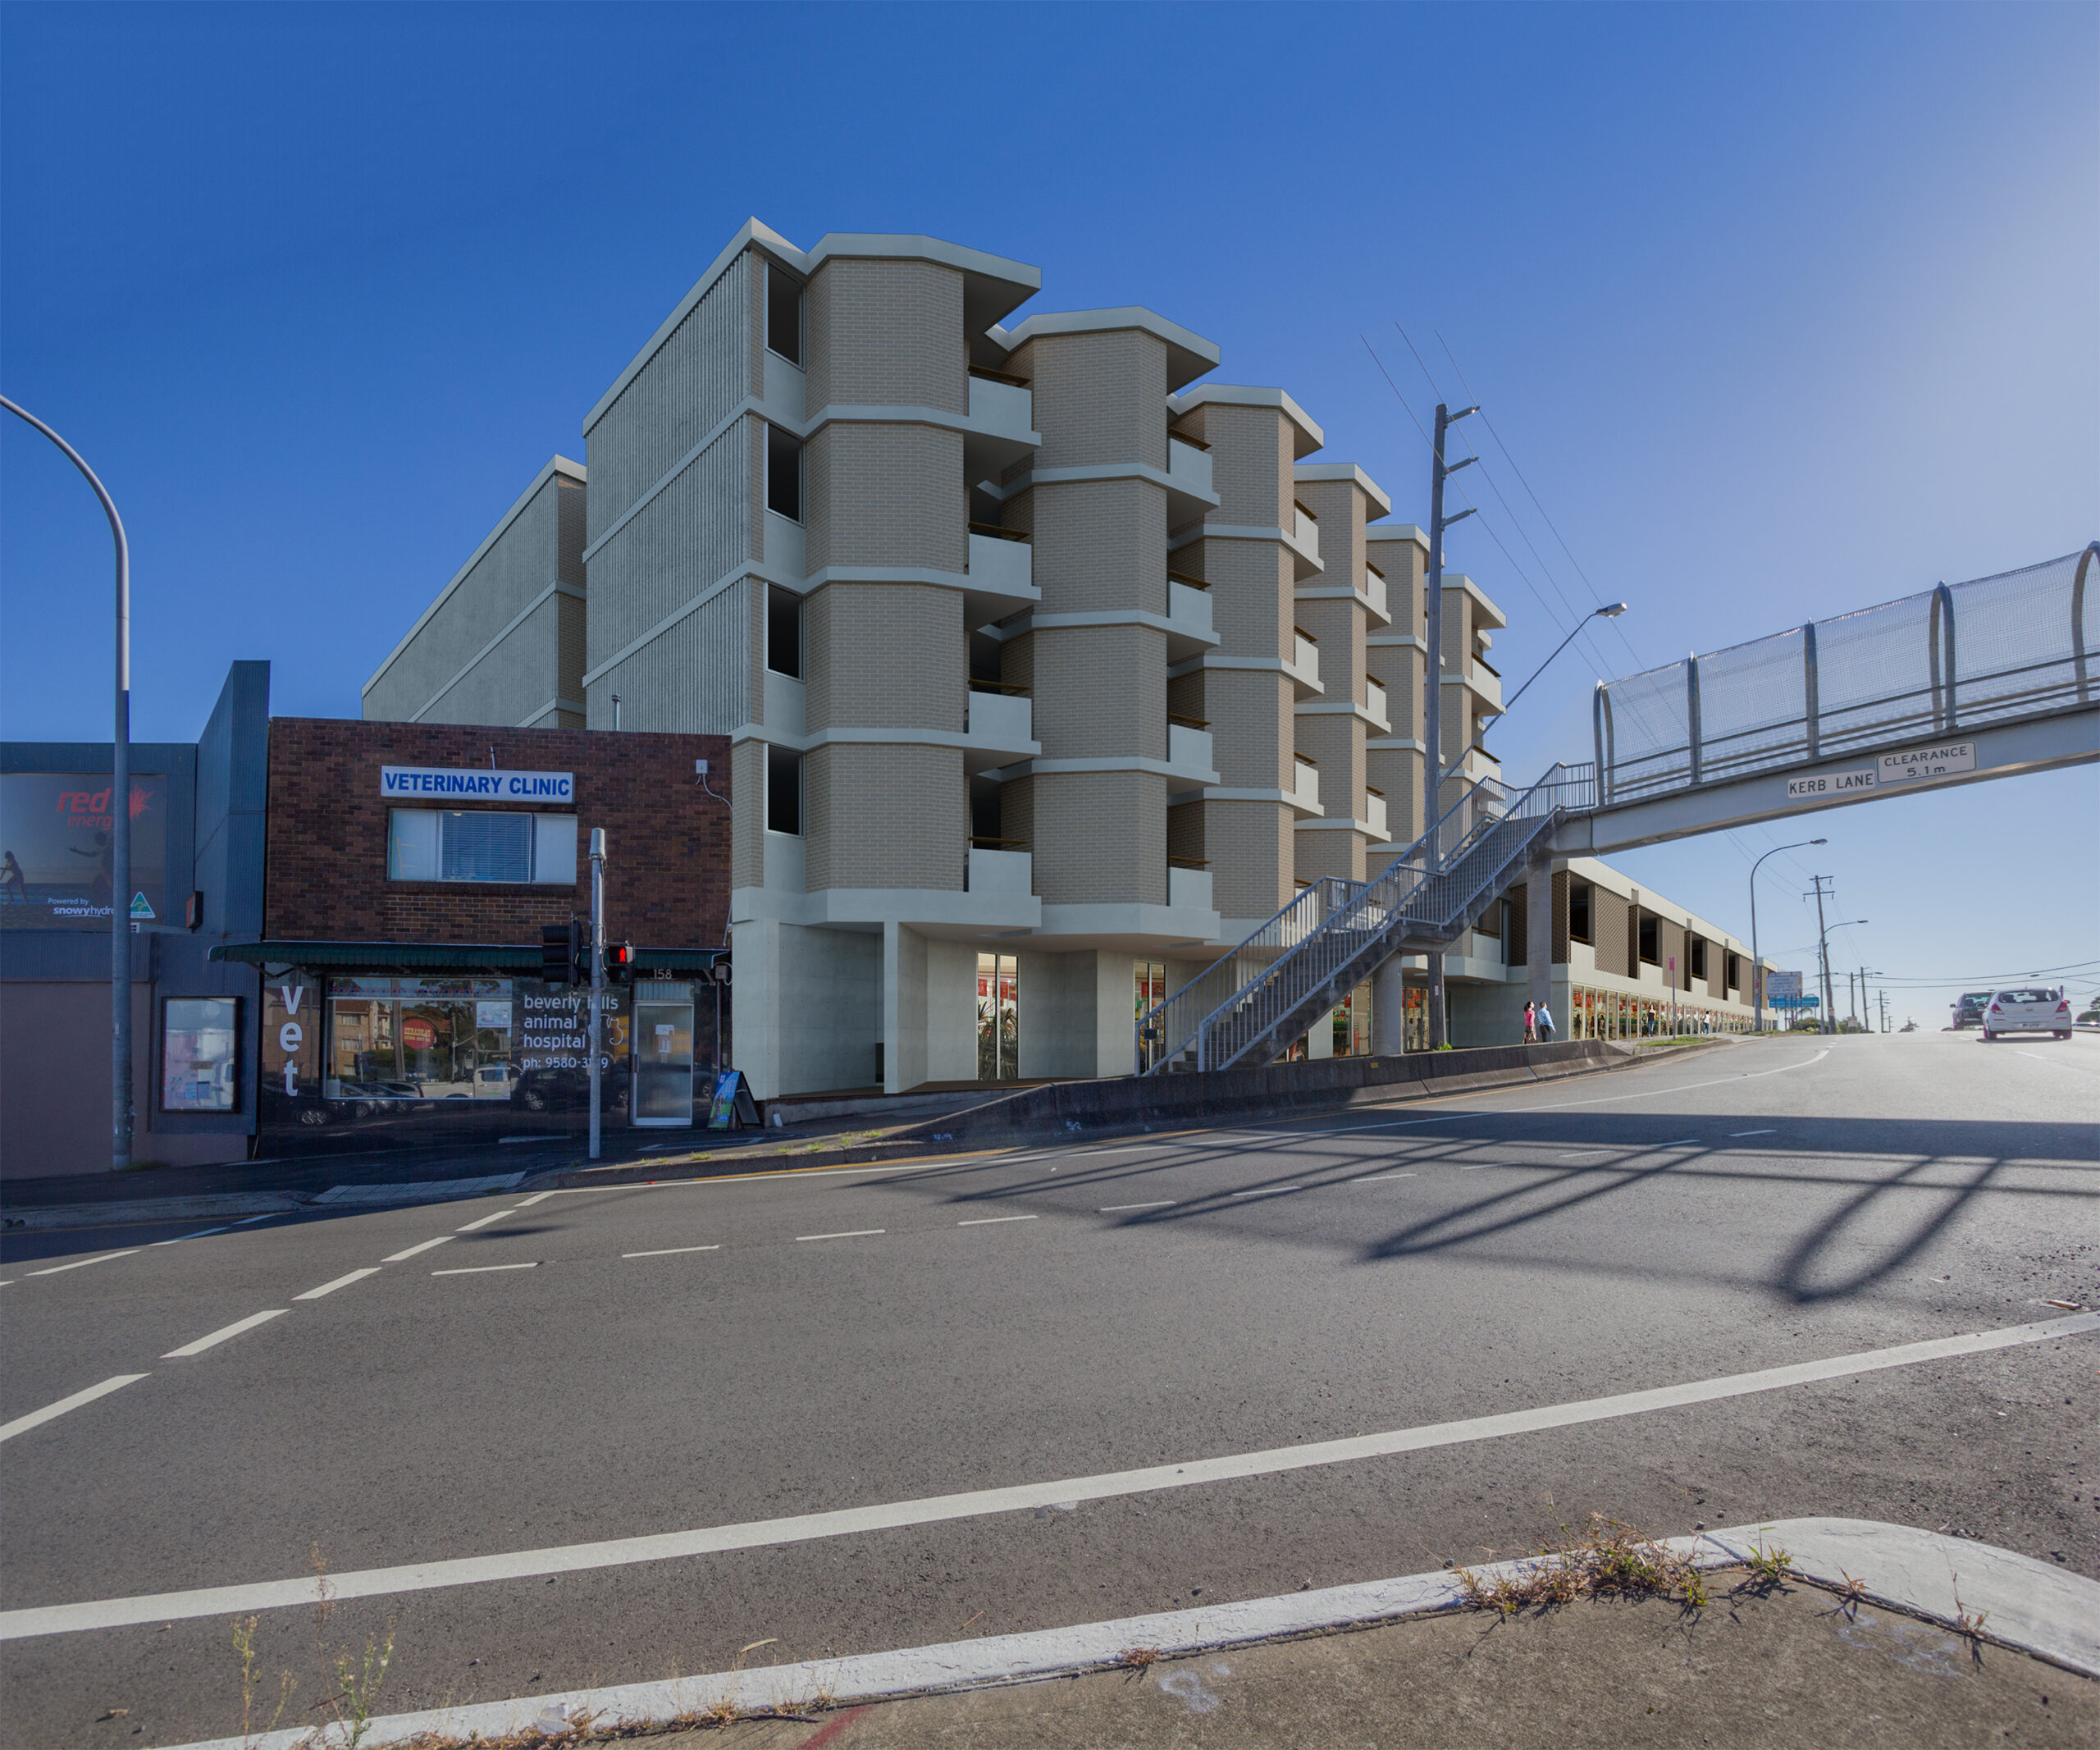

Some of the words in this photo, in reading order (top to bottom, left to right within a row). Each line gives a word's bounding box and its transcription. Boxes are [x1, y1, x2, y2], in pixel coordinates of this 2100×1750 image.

[1884, 746, 1968, 767] CLEARANCE
[385, 772, 503, 794] VETERINARY
[509, 776, 570, 797] CLINIC
[1789, 779, 1827, 794] KERB
[1836, 773, 1874, 789] LANE
[57, 787, 112, 813] red
[67, 816, 113, 830] energ
[48, 897, 79, 905] Powered
[80, 897, 89, 906] by
[653, 968, 673, 980] 158
[524, 994, 581, 1013] beverly
[587, 995, 619, 1010] hlls
[523, 1014, 578, 1029] animal
[279, 985, 304, 1097] vet
[523, 1034, 586, 1052] hospital
[523, 1057, 541, 1070] ph:
